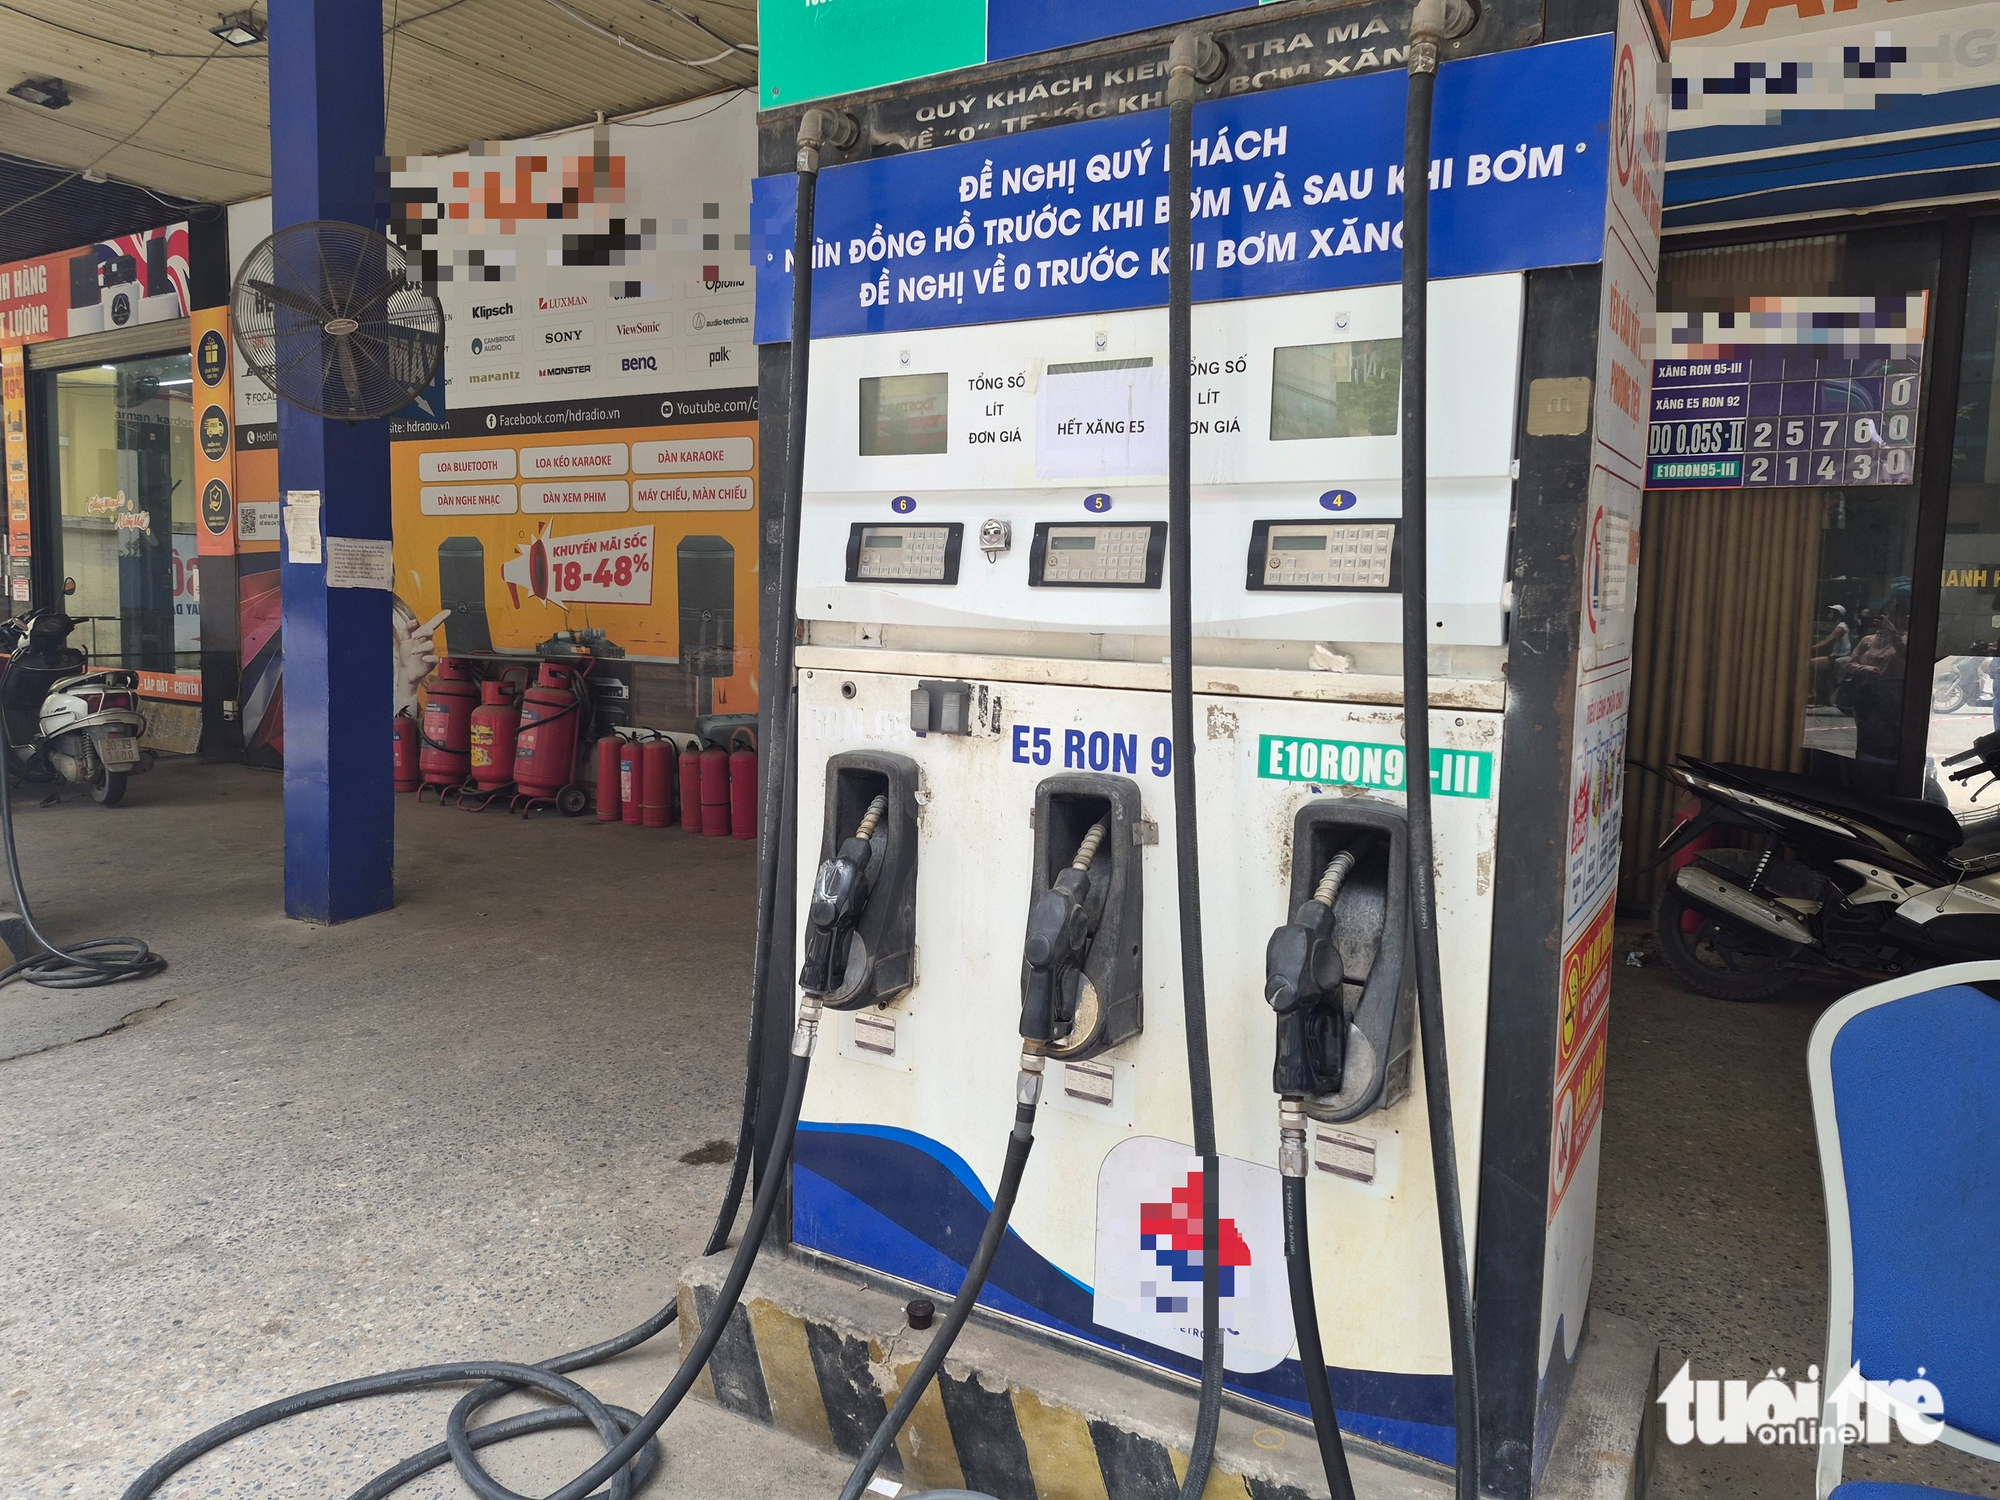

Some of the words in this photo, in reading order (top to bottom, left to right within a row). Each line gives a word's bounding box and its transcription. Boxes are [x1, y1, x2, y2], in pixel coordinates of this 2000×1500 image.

[1324, 44, 1411, 77] XĂN
[915, 97, 977, 122] QUÝ
[986, 76, 1093, 112] KHÁCH
[1241, 33, 1314, 60] TRA
[959, 158, 993, 203] ĐỀ
[1002, 158, 1076, 198] NGHỊ
[1086, 138, 1153, 183] QUÝ
[849, 222, 926, 264] ĐỒNG
[935, 209, 976, 254] HỒ
[984, 204, 1082, 246] TRƯỚC
[1092, 203, 1143, 233] KHI
[1243, 171, 1292, 213] VÀ
[1303, 167, 1374, 206] SAU
[1467, 143, 1565, 187] BƠM
[859, 267, 891, 308] ĐỀ
[898, 268, 965, 304] NGHỊ
[974, 253, 1007, 296] VỀ
[1014, 264, 1031, 290] 0
[1037, 246, 1140, 288] TRƯỚC
[1151, 242, 1205, 276] KI
[1216, 230, 1297, 269] BƠM
[14, 264, 48, 299] HÀNG
[472, 302, 513, 320] Klipsch
[549, 296, 588, 309] LUXMAN
[9, 303, 49, 341] LƯỢNG
[616, 321, 661, 336] ViewSonic
[483, 334, 516, 344] CAMBRIDGE
[545, 330, 583, 344] SONY
[484, 344, 502, 352] AUDIO
[709, 346, 730, 368] polk
[1189, 356, 1220, 377] ỔNG
[1225, 354, 1249, 374] SỐ
[469, 370, 521, 384] marantz
[547, 365, 591, 376] MONSTER
[1658, 364, 1687, 378] XĂNG
[1689, 363, 1712, 377] RON
[968, 372, 1004, 391] TỔNG
[1007, 371, 1027, 389] SỐ
[1197, 389, 1220, 405] LÍT
[1655, 395, 1685, 410] XĂNG
[1686, 397, 1700, 409] E5
[1702, 396, 1724, 408] RON
[1726, 395, 1740, 407] 92
[114, 408, 194, 428] arman/kardon
[500, 407, 621, 429] Facebook.com/hdradio.vn
[985, 403, 1005, 417] LÍT
[389, 421, 405, 433] site:
[1057, 417, 1082, 436] HẾT
[1085, 418, 1125, 435] XĂNG
[1128, 420, 1146, 434] E5
[1189, 420, 1210, 435] ƠN
[1214, 417, 1242, 434] GIÁ
[256, 431, 277, 442] Hotlin
[968, 429, 996, 444] ĐƠN
[999, 427, 1022, 444] GIÁ
[1650, 423, 1672, 455] DO
[1753, 422, 1773, 448] 2
[1785, 421, 1804, 445] 5
[1819, 421, 1839, 445] 7
[535, 457, 551, 468] LOA
[553, 453, 570, 468] KÉO
[572, 455, 612, 467] KARAOKE
[658, 449, 676, 463] DÀN
[678, 450, 724, 463] KARAOKE
[437, 461, 452, 473] LOA
[453, 460, 498, 473] BLUETOOTH
[1657, 462, 1735, 478] E10RON95-III
[1750, 457, 1769, 482] 2
[1816, 456, 1836, 480] 4
[1852, 456, 1872, 480] 3
[437, 491, 455, 505] DÀN
[456, 494, 477, 505] NGHE
[478, 494, 500, 508] NHẠC
[543, 488, 561, 503] DÀN
[562, 492, 582, 503] XEM
[583, 491, 606, 503] PHIM
[638, 485, 659, 501] MÁY
[660, 486, 690, 503] CHIẾU,
[692, 486, 718, 500] MÀN
[718, 485, 747, 500] CHIẾU
[1332, 494, 1343, 507] 4
[900, 499, 907, 511] 6
[1095, 498, 1103, 510] 5
[553, 539, 597, 558] KHUYẾN
[600, 537, 622, 553] MÃI
[623, 532, 648, 550] SỐC
[552, 553, 649, 592] 18-48%
[1012, 724, 1052, 766] E5
[1063, 728, 1138, 774] RON
[1151, 736, 1181, 778] 9
[1269, 740, 1480, 793] E10RON9-III
